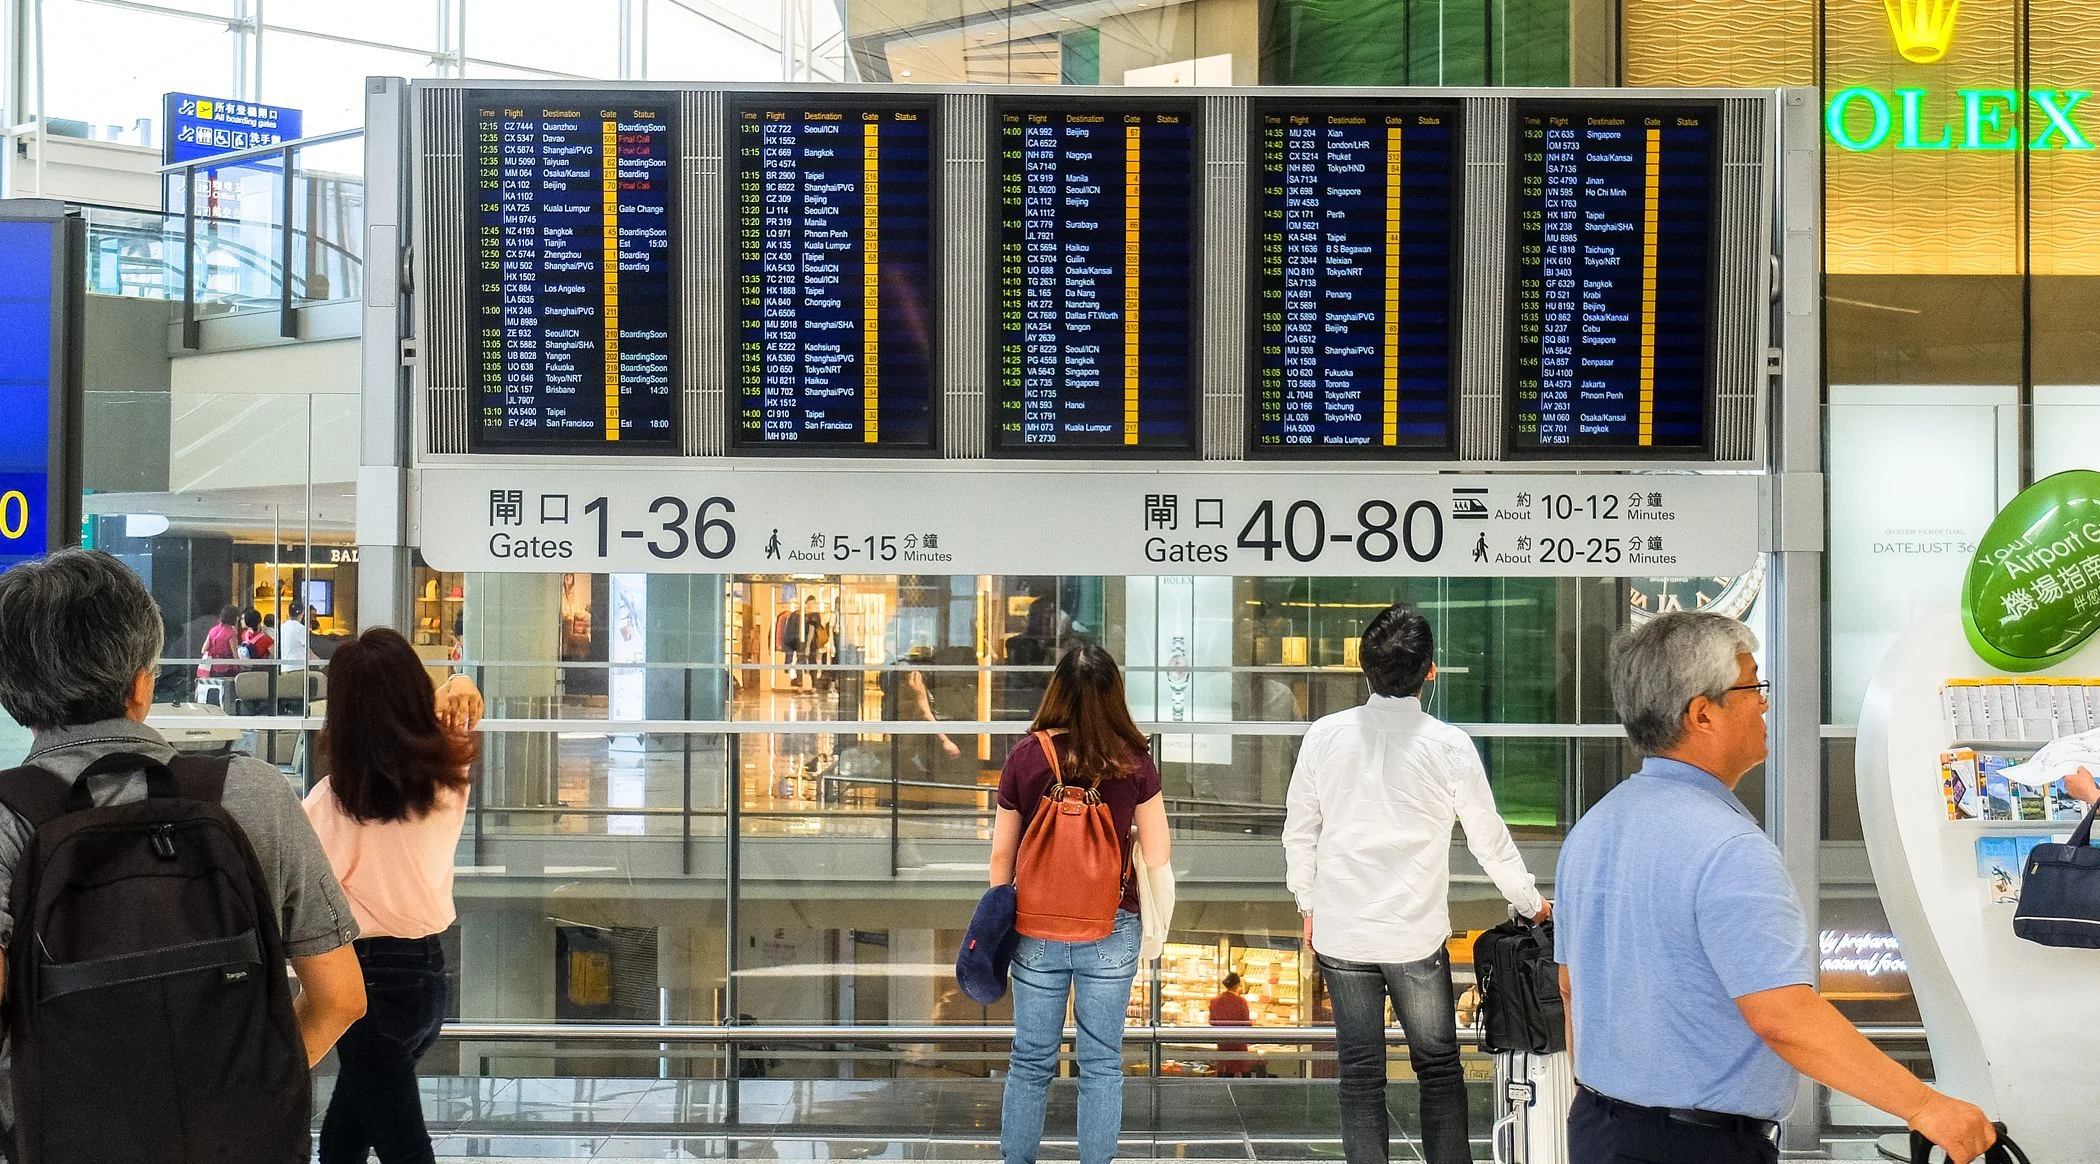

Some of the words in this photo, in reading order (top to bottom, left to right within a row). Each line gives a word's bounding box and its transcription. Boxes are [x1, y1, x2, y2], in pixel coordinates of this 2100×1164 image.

[505, 110, 523, 118] Flight
[601, 110, 616, 118] Gate
[766, 112, 785, 120] Flight
[895, 113, 916, 121] Status
[1029, 115, 1047, 123] Flight
[1124, 115, 1140, 123] Gate
[1157, 115, 1178, 123] Status
[226, 115, 256, 128] boarding
[1290, 117, 1309, 125] Flight
[1550, 118, 1568, 126] Flight
[543, 123, 577, 131] Quanzhou
[618, 124, 666, 133] BoardingSoon
[1066, 129, 1089, 137] Beijing
[1587, 132, 1621, 140] Singapore
[1328, 141, 1369, 149] London/LHR
[804, 149, 834, 157] Bangkok
[619, 171, 649, 179] Boarding
[1326, 291, 1351, 299] Penang
[1066, 357, 1094, 365] Bangkok
[1065, 380, 1099, 388] Singapore
[805, 411, 824, 419] Taipei
[1580, 425, 1609, 433] Bangkok
[490, 490, 568, 526] 閘口
[1517, 492, 1530, 507] 約
[1542, 495, 1618, 519] 10-12
[1628, 492, 1662, 507] 分鐘
[1145, 495, 1223, 531] 閘口
[1495, 510, 1530, 519] About
[1628, 510, 1674, 520] Minutes
[585, 497, 735, 559] 1-36
[1237, 500, 1443, 562] 40-80
[490, 533, 572, 558] Gates
[811, 533, 825, 548] 約
[834, 536, 896, 560] 5-15
[904, 534, 938, 548] 分鐘
[1145, 538, 1227, 562] Gates
[1517, 536, 1531, 550] 約
[1540, 538, 1621, 563] 20-25
[1629, 536, 1662, 551] 分鐘
[1874, 542, 1952, 554] DATEJUST
[1957, 542, 1976, 552] 36
[331, 550, 360, 562] BAL
[789, 550, 824, 560] About
[905, 551, 951, 561] Minutes
[1495, 553, 1531, 563] About
[1629, 550, 1676, 563] Minutes
[2004, 531, 2084, 580] Airport
[2082, 523, 2100, 543] G
[2074, 586, 2100, 613] 伴您
